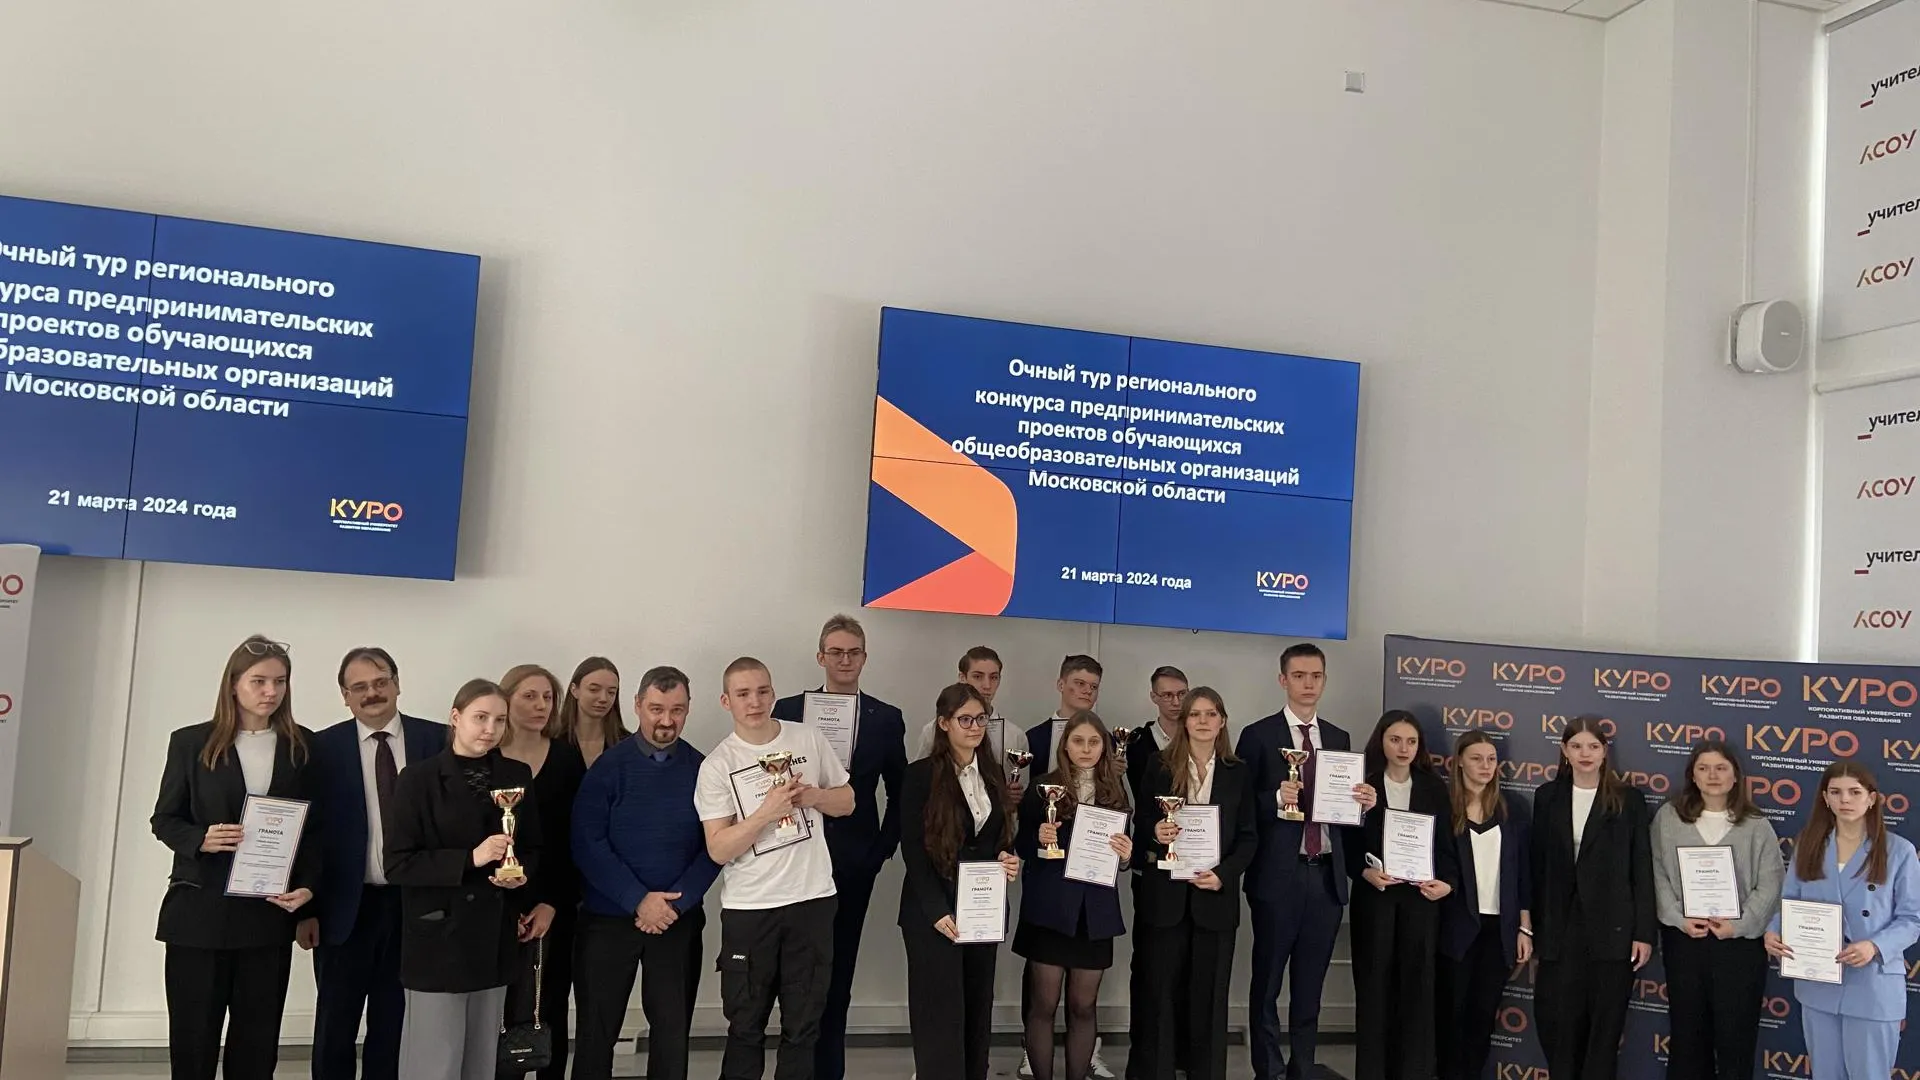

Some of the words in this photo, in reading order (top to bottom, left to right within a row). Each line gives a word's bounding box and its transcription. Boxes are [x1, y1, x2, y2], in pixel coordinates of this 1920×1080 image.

[1871, 66, 1920, 98] учите
[0, 244, 76, 268] чный
[83, 253, 127, 278] тур
[134, 258, 335, 298] регионального
[68, 288, 374, 338] предпринимательских
[127, 322, 313, 361] обучающихся
[224, 365, 394, 399] организаций
[1008, 358, 1076, 383] Очный
[1080, 370, 1111, 390] тур
[1116, 373, 1257, 402] регионального
[5, 370, 177, 407] Московской
[183, 388, 290, 418] области
[975, 389, 1065, 414] конкурса
[1070, 400, 1285, 435] предпринимательских
[1018, 420, 1107, 442] проектов
[1111, 427, 1243, 456] обучающихся
[951, 436, 1177, 473] общеобразовательных
[1180, 461, 1300, 487] организаций
[1028, 468, 1147, 497] Московской
[1151, 481, 1227, 504] области
[48, 489, 70, 506] 21
[77, 494, 138, 513] марта
[142, 496, 189, 515] 2024
[193, 502, 237, 520] года
[330, 498, 404, 522] КУРО
[1061, 566, 1077, 580] 21
[1081, 570, 1123, 585] марта
[1126, 571, 1158, 586] 2024
[1161, 577, 1192, 591] года
[1256, 570, 1309, 590] КУРО
[1396, 656, 1467, 677] КУРО
[1492, 662, 1566, 684] КУРО
[1594, 667, 1672, 691] КУРО
[1701, 674, 1782, 699] КУРО
[1803, 675, 1918, 707] КУРО
[1443, 706, 1514, 730] КУРО
[1808, 706, 1866, 715] КОРПОРАТИВНЫЙ
[1866, 710, 1913, 718] УНИВЕРСИТЕТ
[1818, 713, 1852, 721] РАЗВИТИЯ
[1852, 715, 1902, 724] ОБРАЗОВАНИЯ
[1541, 713, 1617, 738] КУО
[1645, 722, 1726, 744] КУРО
[1745, 723, 1859, 757] КУРО
[790, 756, 808, 766] HES
[1879, 793, 1910, 814] О
[258, 828, 284, 836] ГРАМОТА
[1762, 996, 1790, 1018] О
